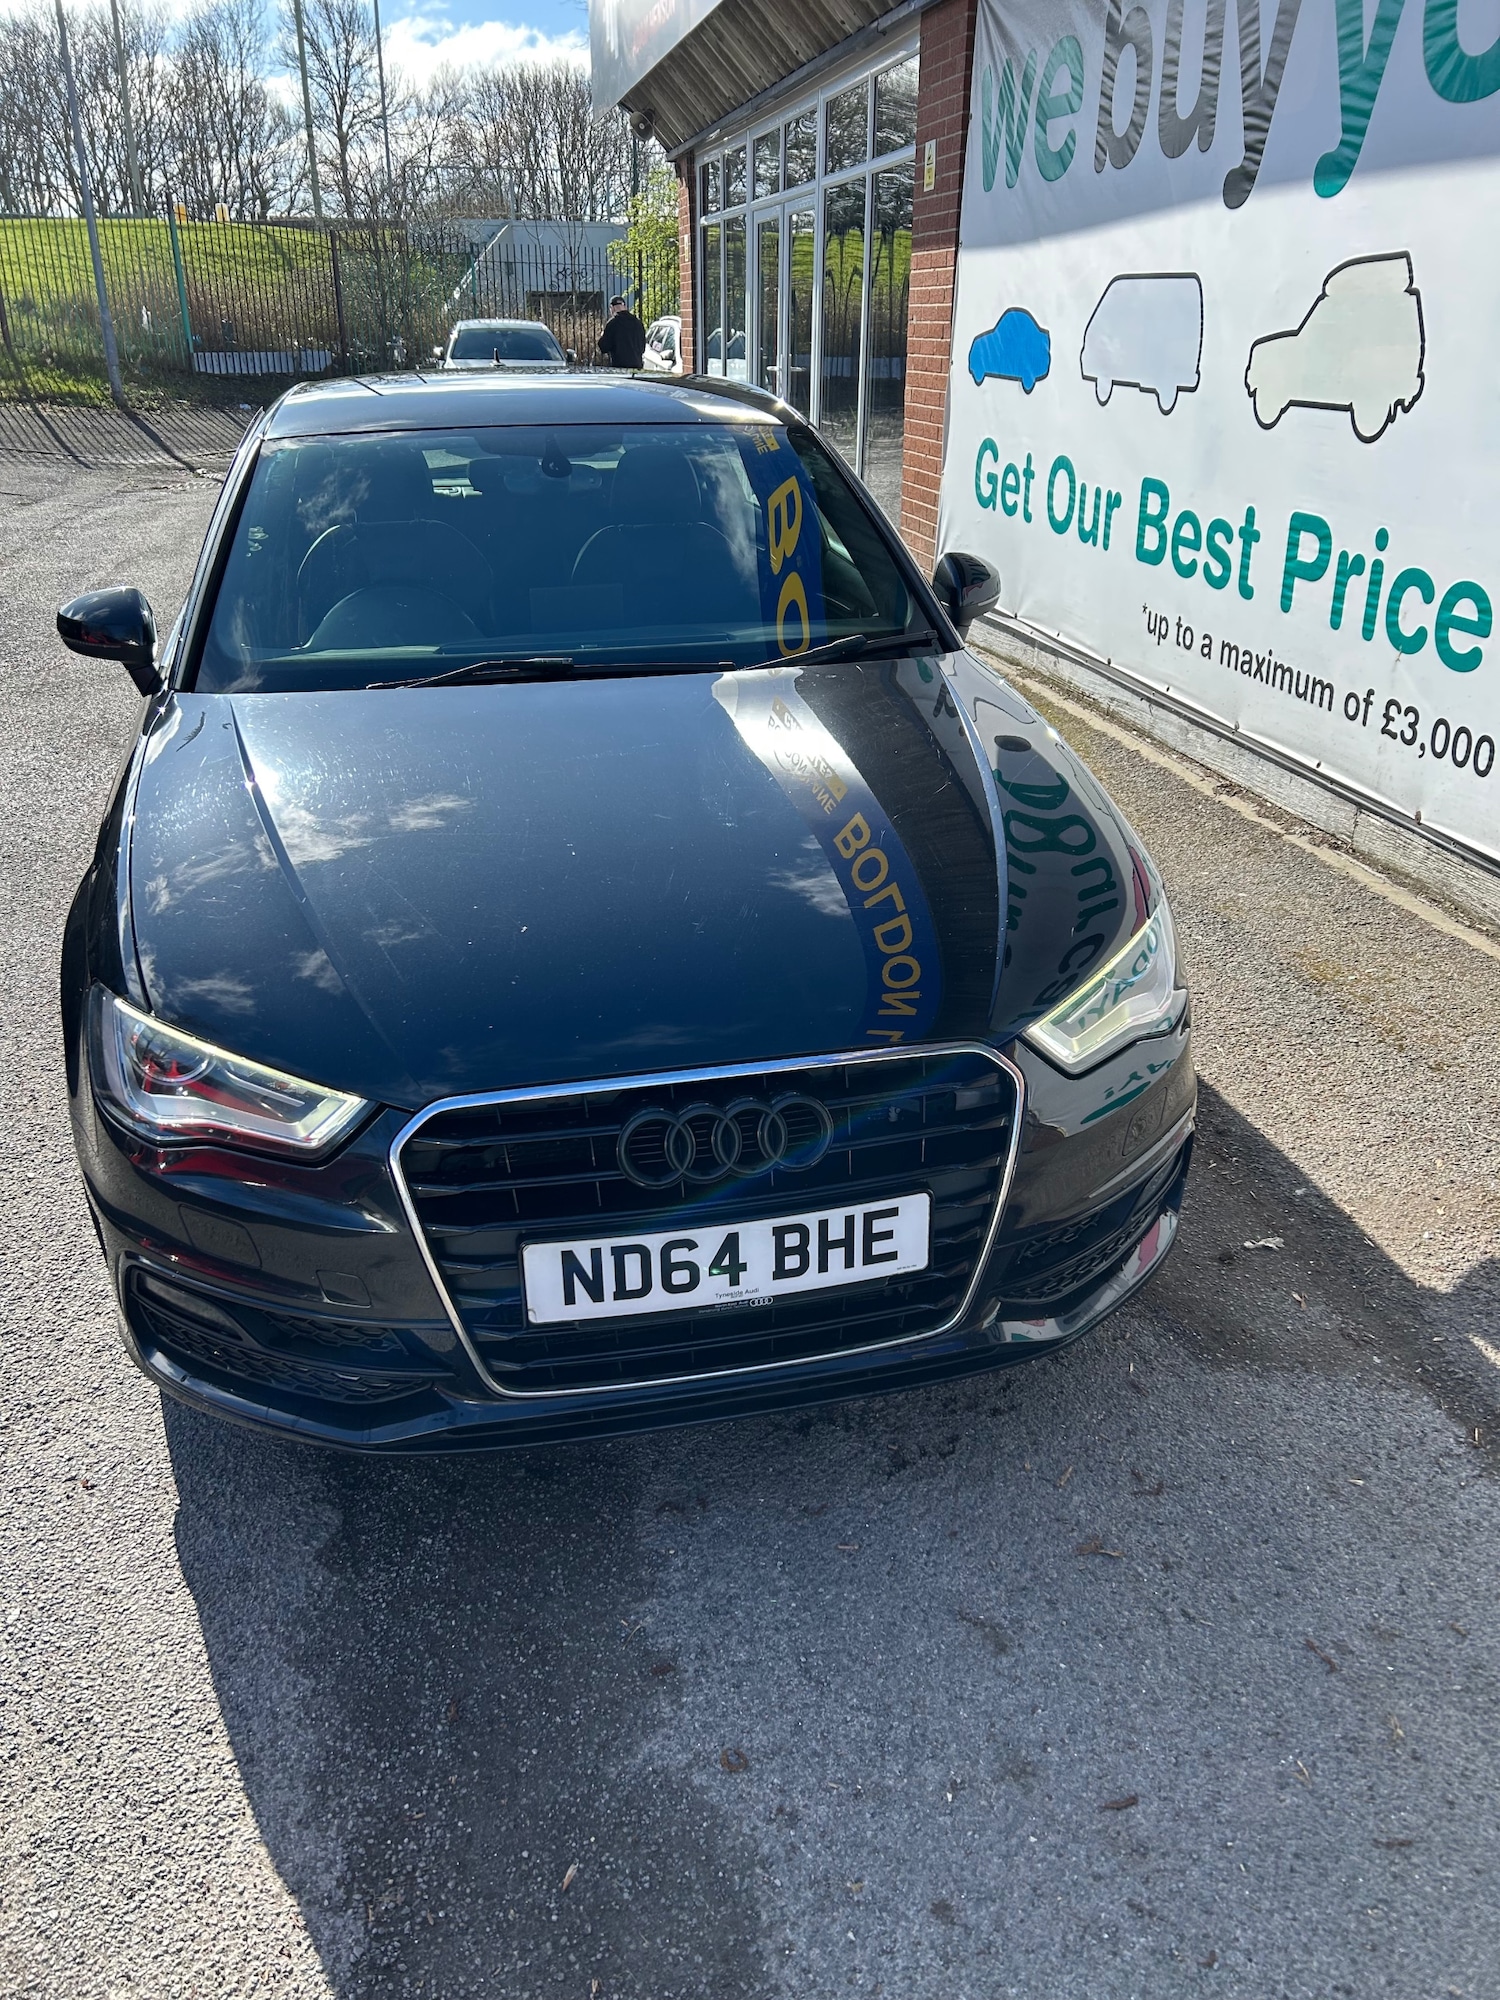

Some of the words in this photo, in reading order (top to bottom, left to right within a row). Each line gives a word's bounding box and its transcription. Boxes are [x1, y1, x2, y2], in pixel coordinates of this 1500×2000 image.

[974, 437, 1036, 524] Get
[1046, 454, 1122, 551] Our
[1135, 476, 1261, 601] Best
[1279, 511, 1493, 673] Price
[1176, 616, 1194, 651] to
[1200, 633, 1213, 660] a
[1220, 639, 1335, 712] maximum
[1343, 687, 1375, 728] of
[1380, 698, 1496, 778] £3,000
[560, 1230, 748, 1306] ND64
[772, 1206, 900, 1281] BHE
[744, 1287, 760, 1295] Audi
